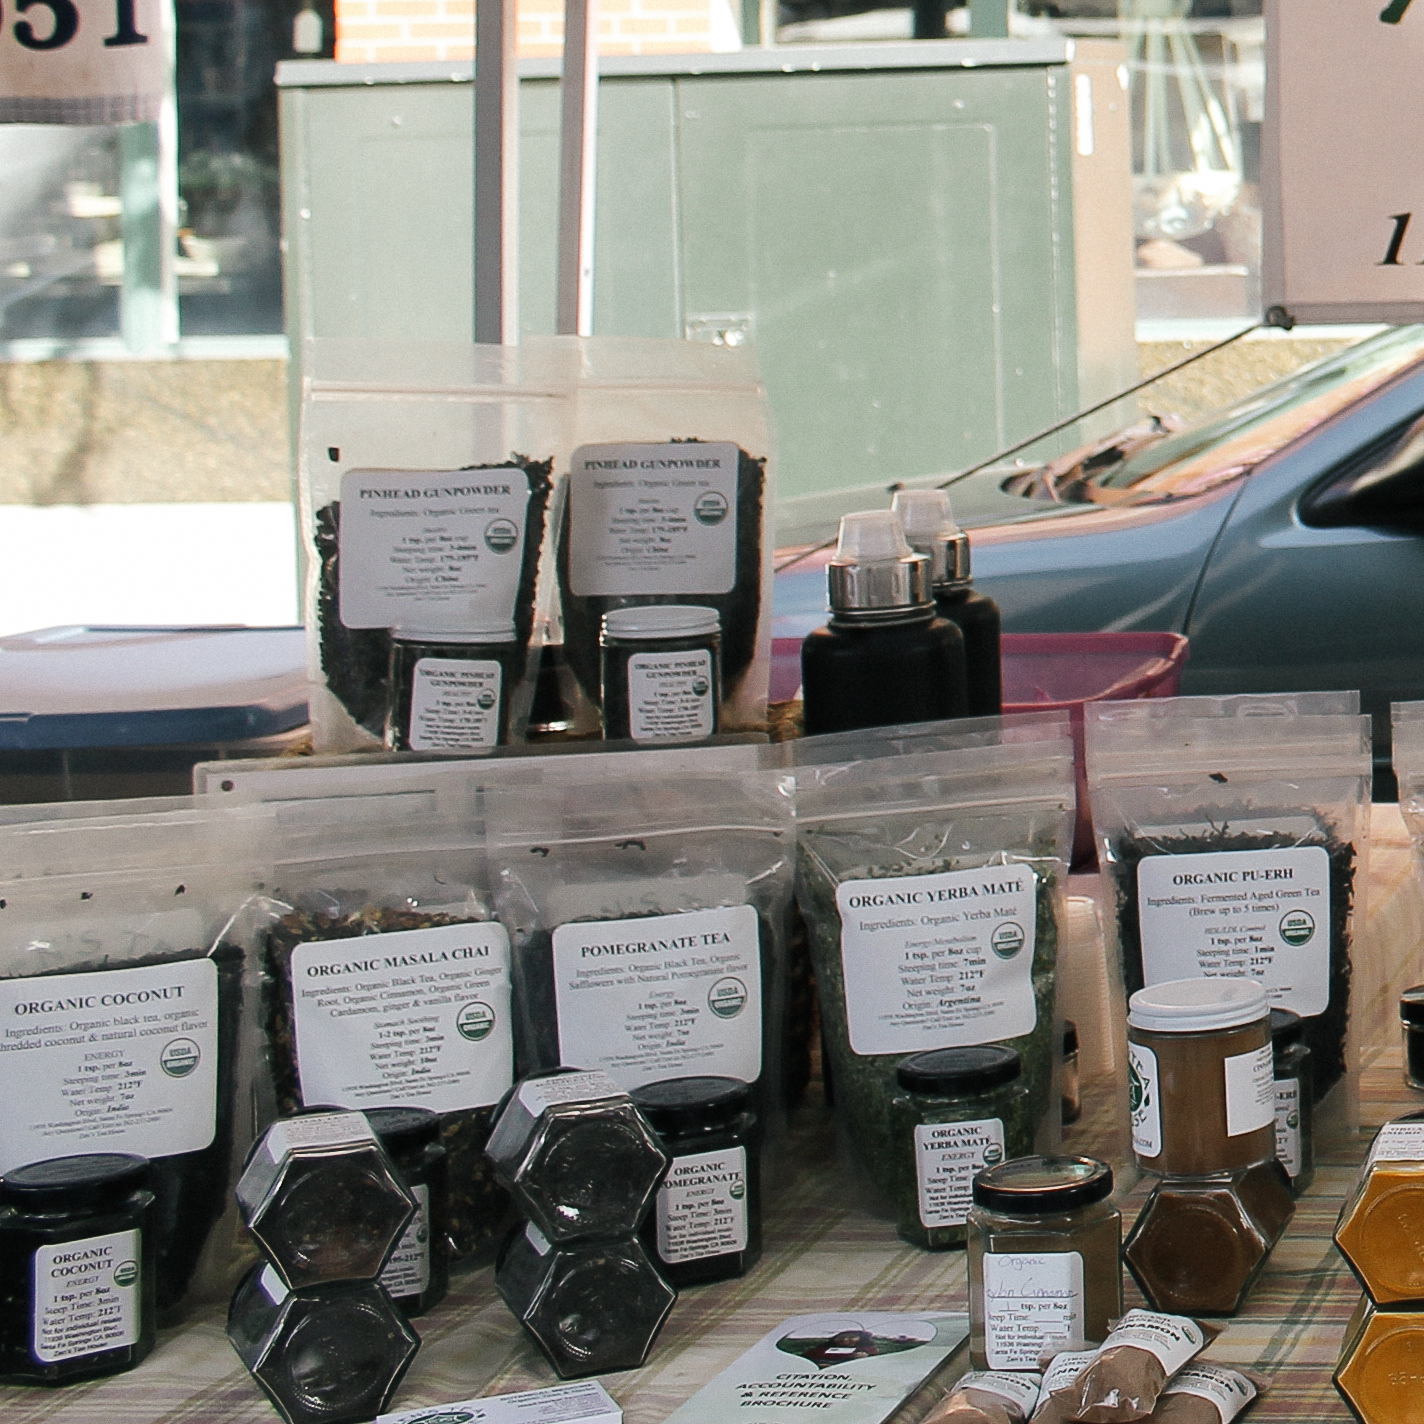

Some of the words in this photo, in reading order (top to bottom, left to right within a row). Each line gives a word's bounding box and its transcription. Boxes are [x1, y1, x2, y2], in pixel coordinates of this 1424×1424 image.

[359, 489, 420, 498] PINHEAD
[423, 485, 510, 497] GUNPOWDER
[1172, 871, 1238, 885] ORGANIC
[1242, 868, 1292, 881] PU-ERH
[849, 892, 922, 908] ORGANIC
[927, 886, 978, 901] YERBA
[581, 935, 696, 957] POMEGRANATE
[700, 932, 730, 945] TEA
[306, 959, 379, 977] ORGANIC
[384, 951, 448, 967] MASALA
[451, 945, 488, 959] CHAI
[14, 996, 95, 1015] ORGANIC
[100, 985, 184, 1006] COCONUT
[4, 1024, 65, 1039] Ingredients:
[69, 1019, 110, 1032] Organic
[113, 1014, 139, 1025] black
[143, 1014, 161, 1022] tea,
[163, 1007, 199, 1021] organic
[0, 1036, 41, 1052] hredded
[931, 1126, 981, 1138] ORGANIC
[674, 1161, 724, 1175] ORGANIC
[52, 1246, 112, 1264] ORGANIC
[50, 1258, 113, 1277] COCONUT
[735, 1381, 876, 1390] ACCOUNTABILITY
[758, 1391, 851, 1399] REFERENCE
[740, 1400, 832, 1408] BROCHURE
